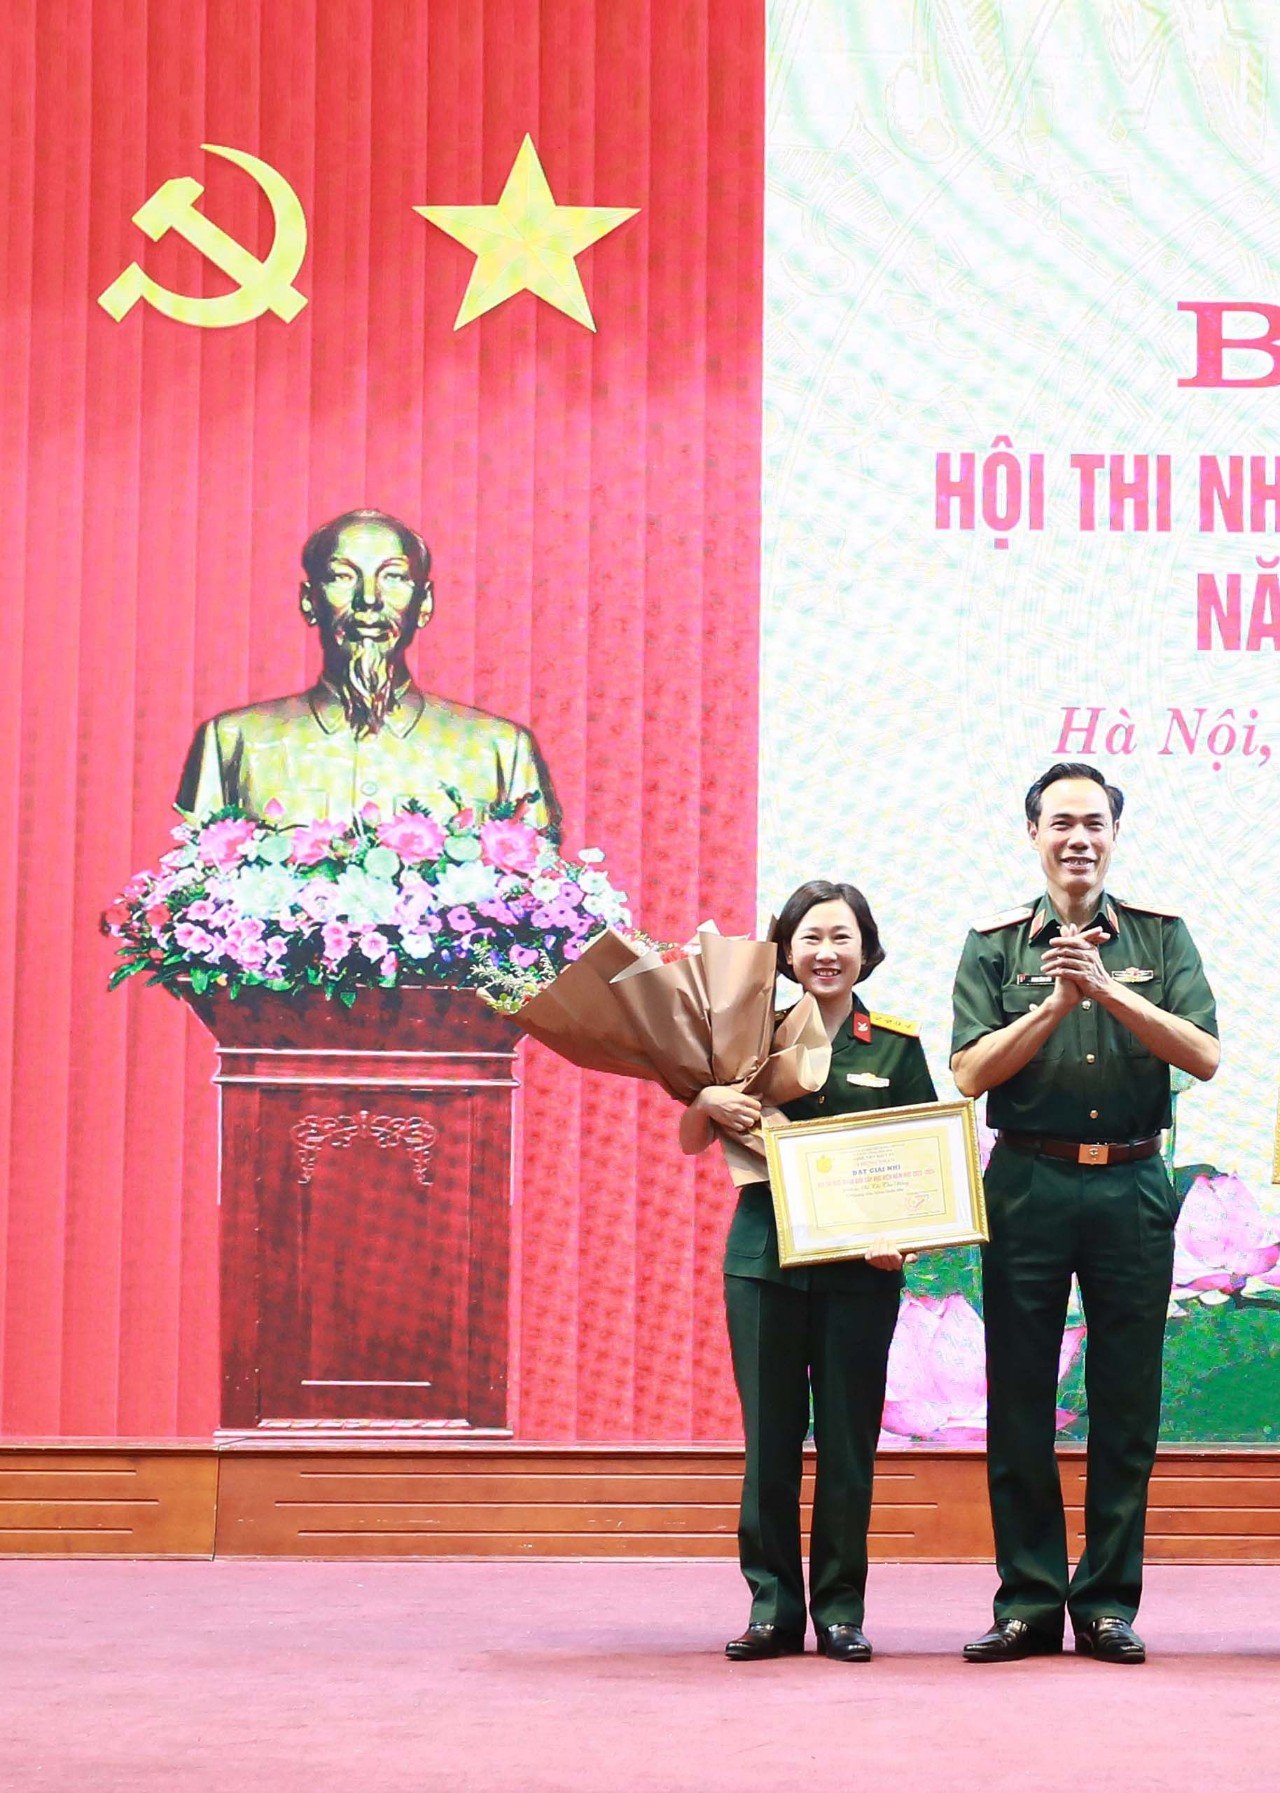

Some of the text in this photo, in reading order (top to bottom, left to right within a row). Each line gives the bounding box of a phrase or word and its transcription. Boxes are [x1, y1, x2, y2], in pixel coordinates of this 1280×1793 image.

[935, 434, 1045, 550] HỘI
[1070, 453, 1172, 532] THI
[1052, 706, 1137, 755] Hà
[1157, 708, 1272, 772] Nội,
